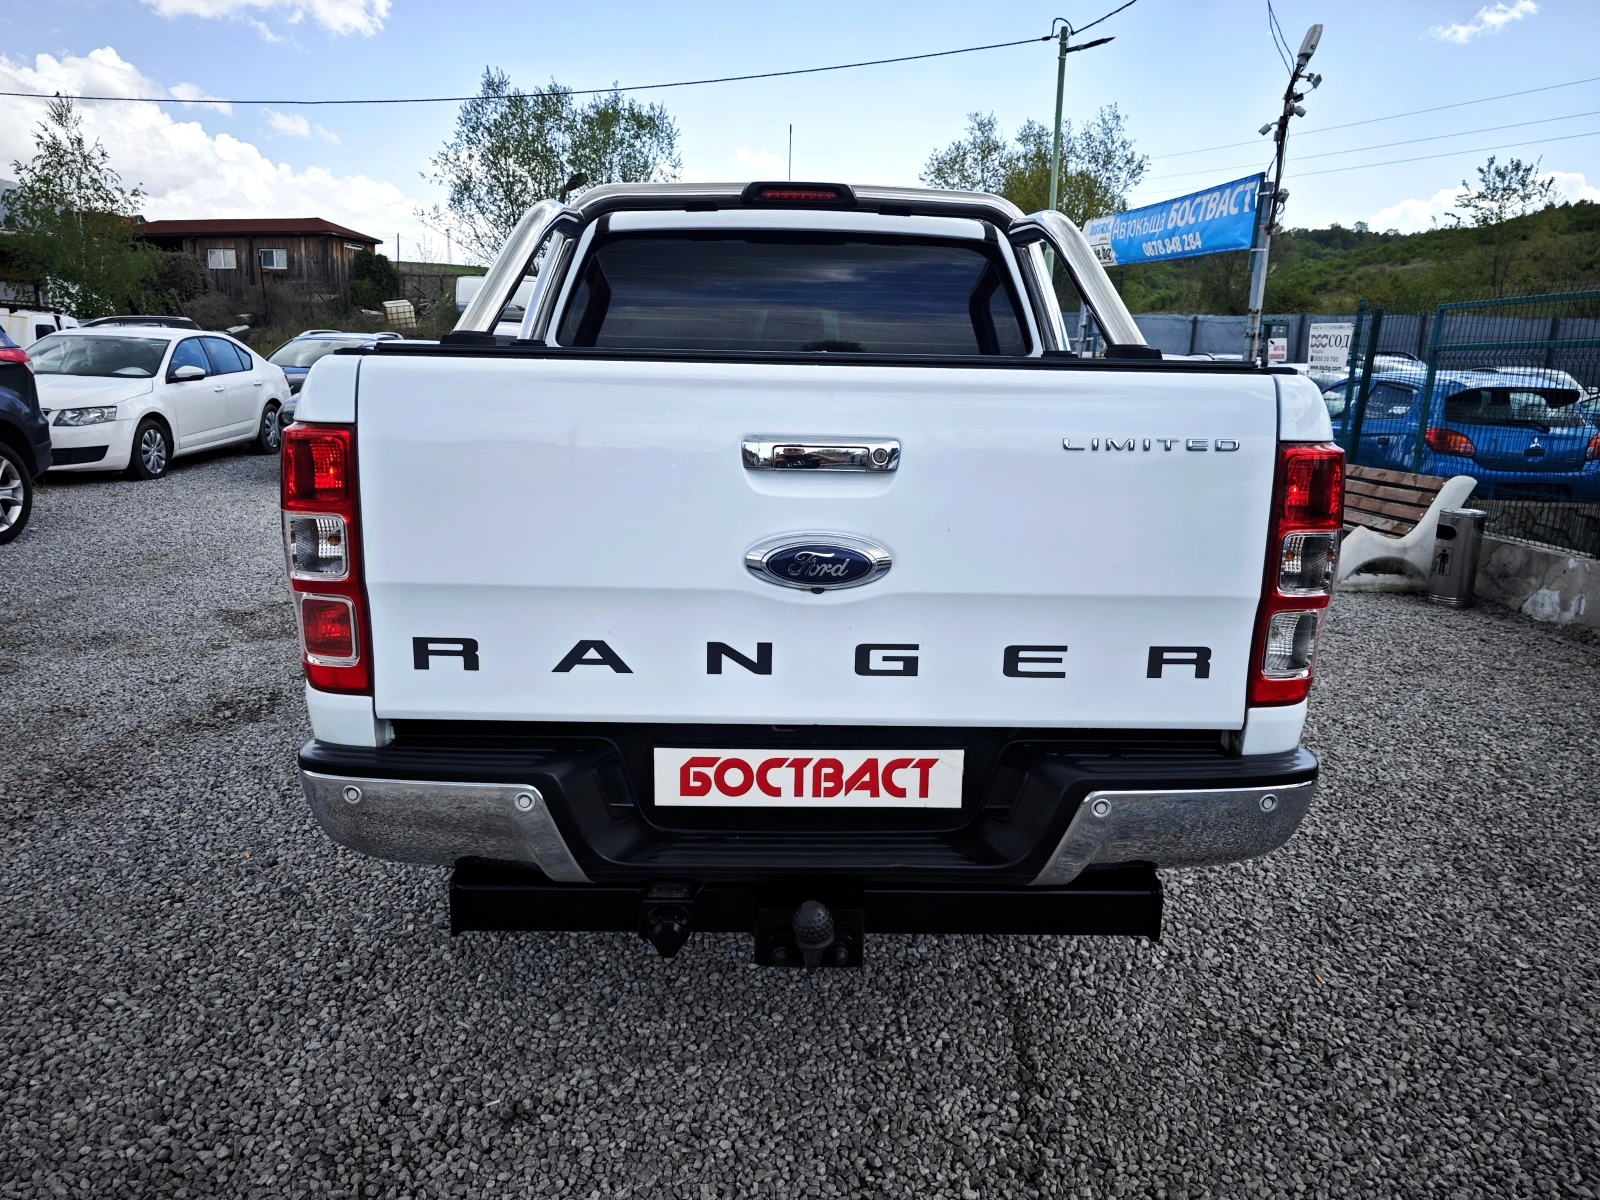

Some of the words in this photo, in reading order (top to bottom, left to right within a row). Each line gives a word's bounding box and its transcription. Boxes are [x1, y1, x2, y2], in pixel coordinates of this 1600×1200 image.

[1167, 182, 1257, 230] БОСТВАСТ
[1142, 240, 1166, 257] 0878
[1165, 237, 1182, 254] 848
[1183, 232, 1202, 250] 284
[1328, 334, 1351, 349] СОД
[1062, 437, 1240, 452] LIMITED
[788, 551, 851, 577] Ford
[413, 636, 1212, 679] RANGER
[679, 756, 940, 799] БОСТВАСТ
